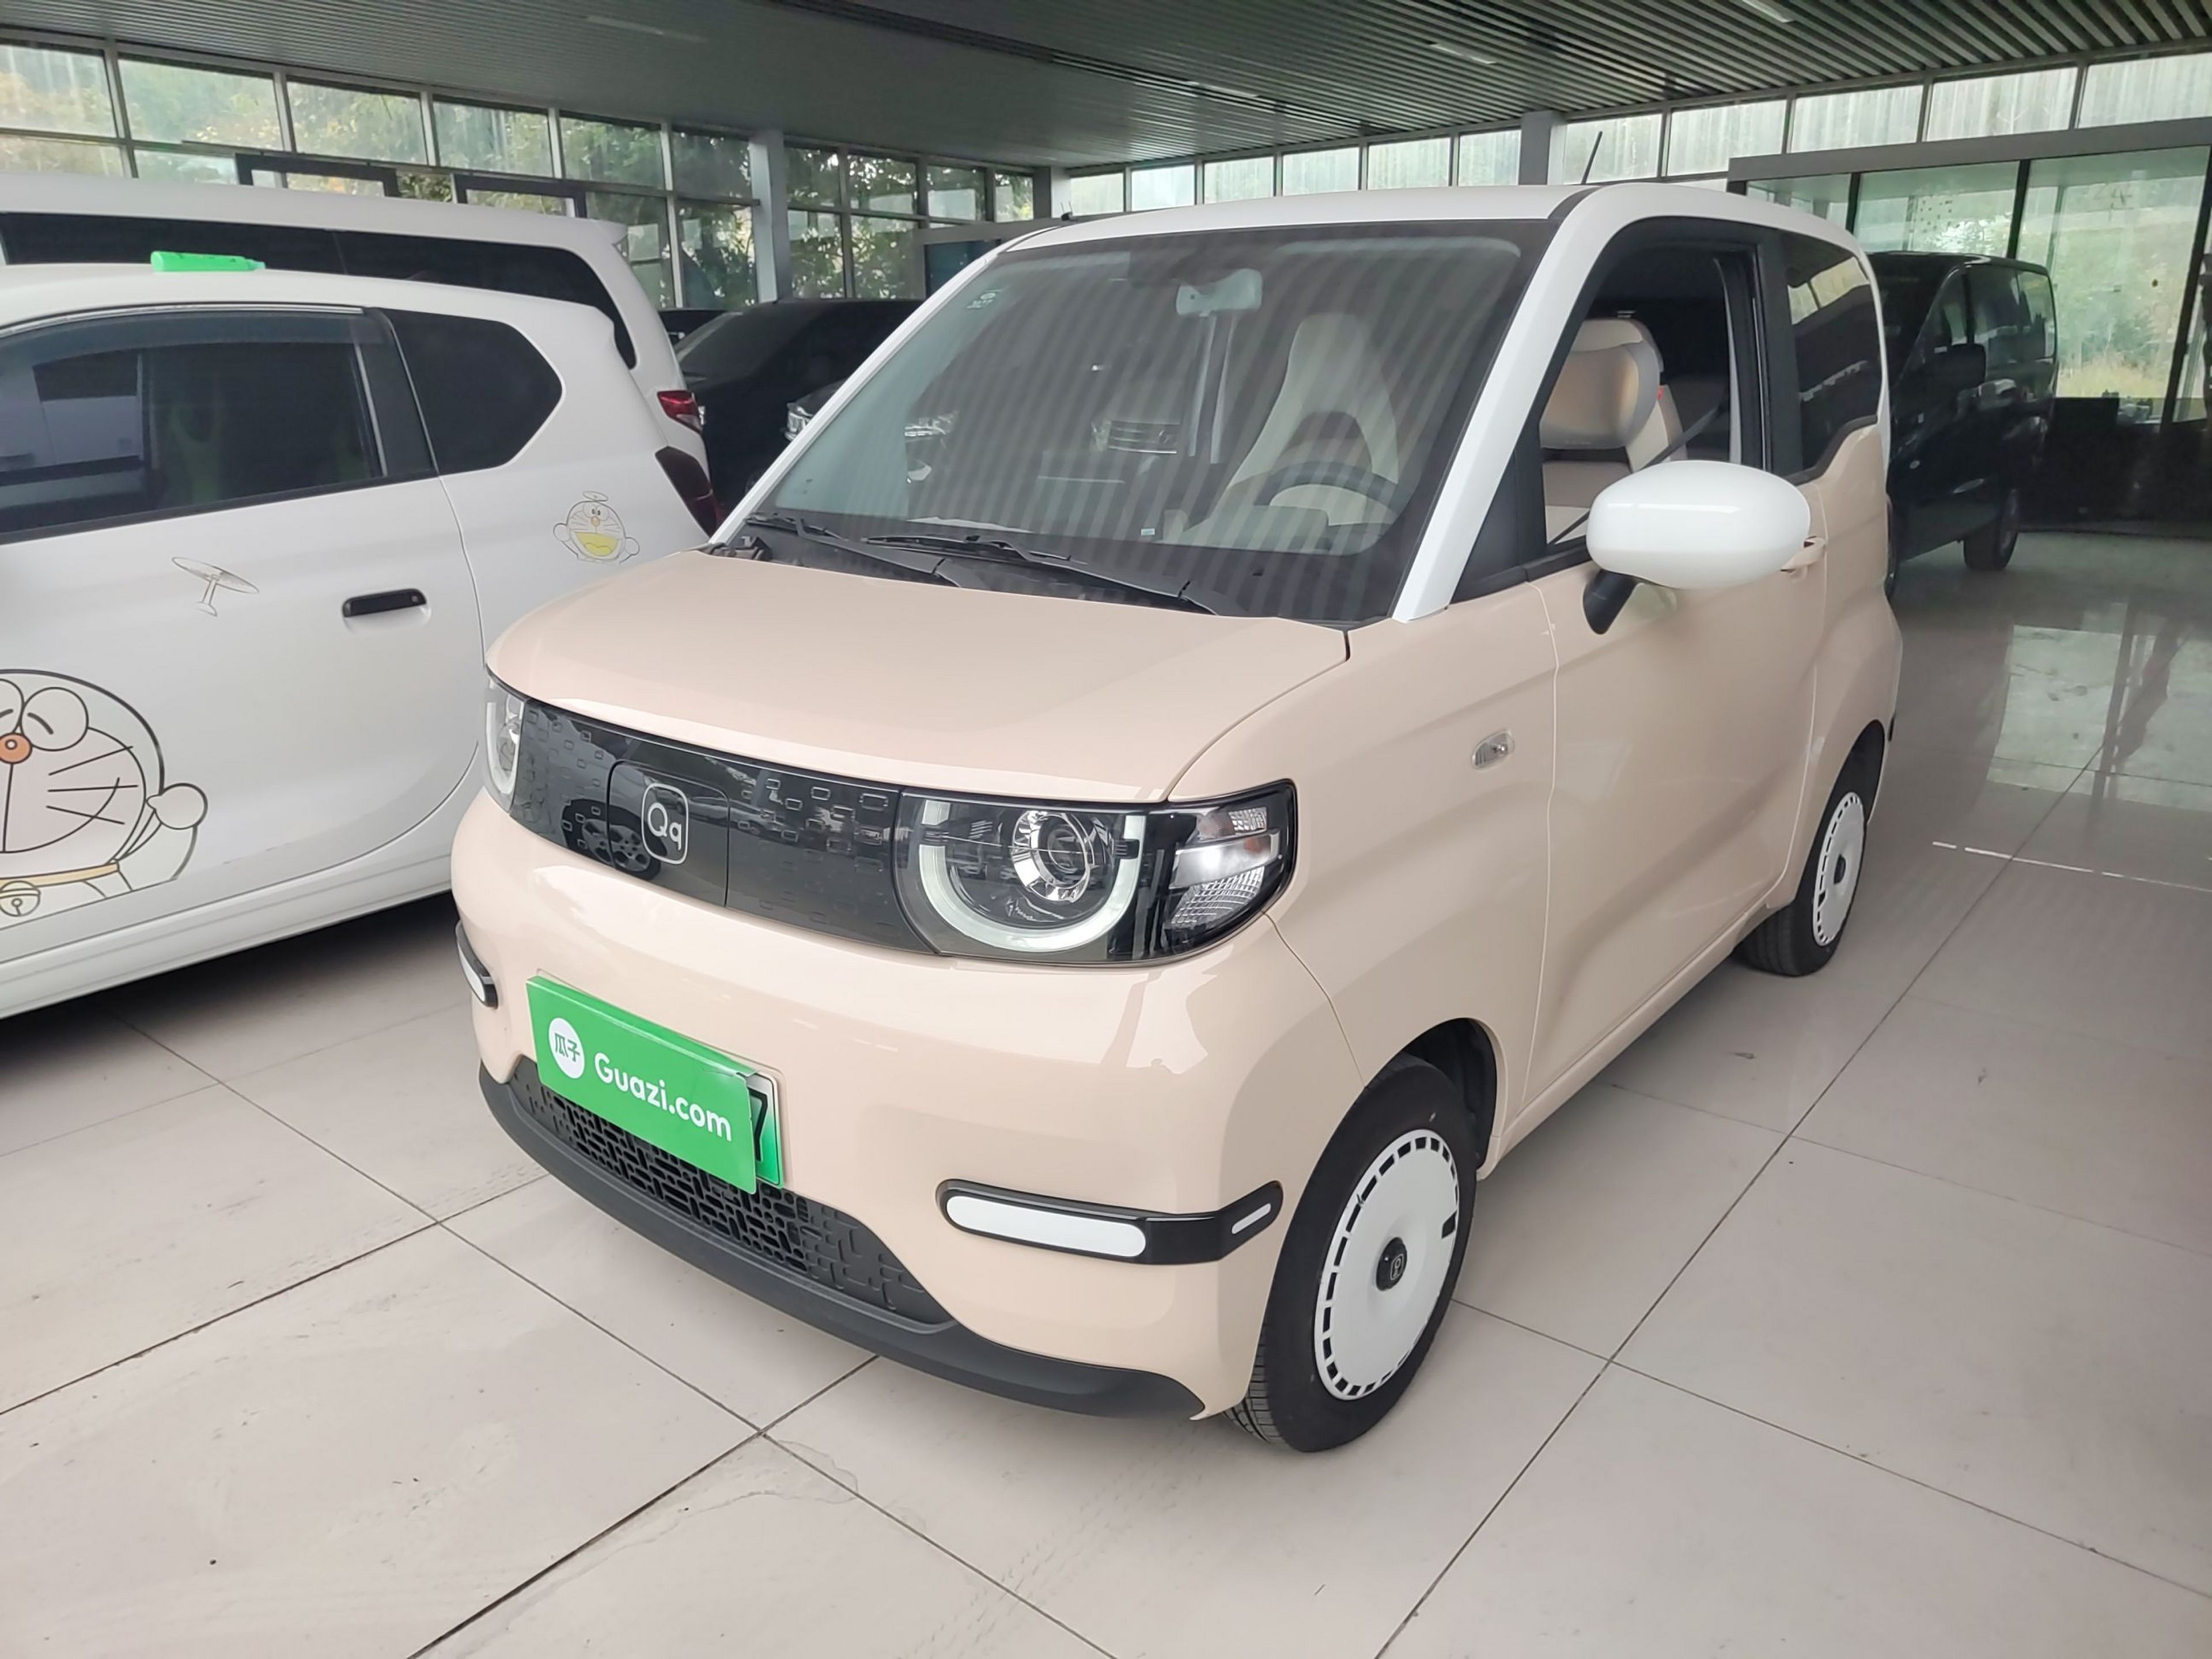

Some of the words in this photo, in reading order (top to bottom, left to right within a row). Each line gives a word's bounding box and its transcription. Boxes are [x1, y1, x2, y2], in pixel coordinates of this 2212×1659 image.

[647, 802, 681, 850] Qq
[555, 1033, 580, 1062] 瓜子
[594, 1052, 732, 1141] Guazi.com
